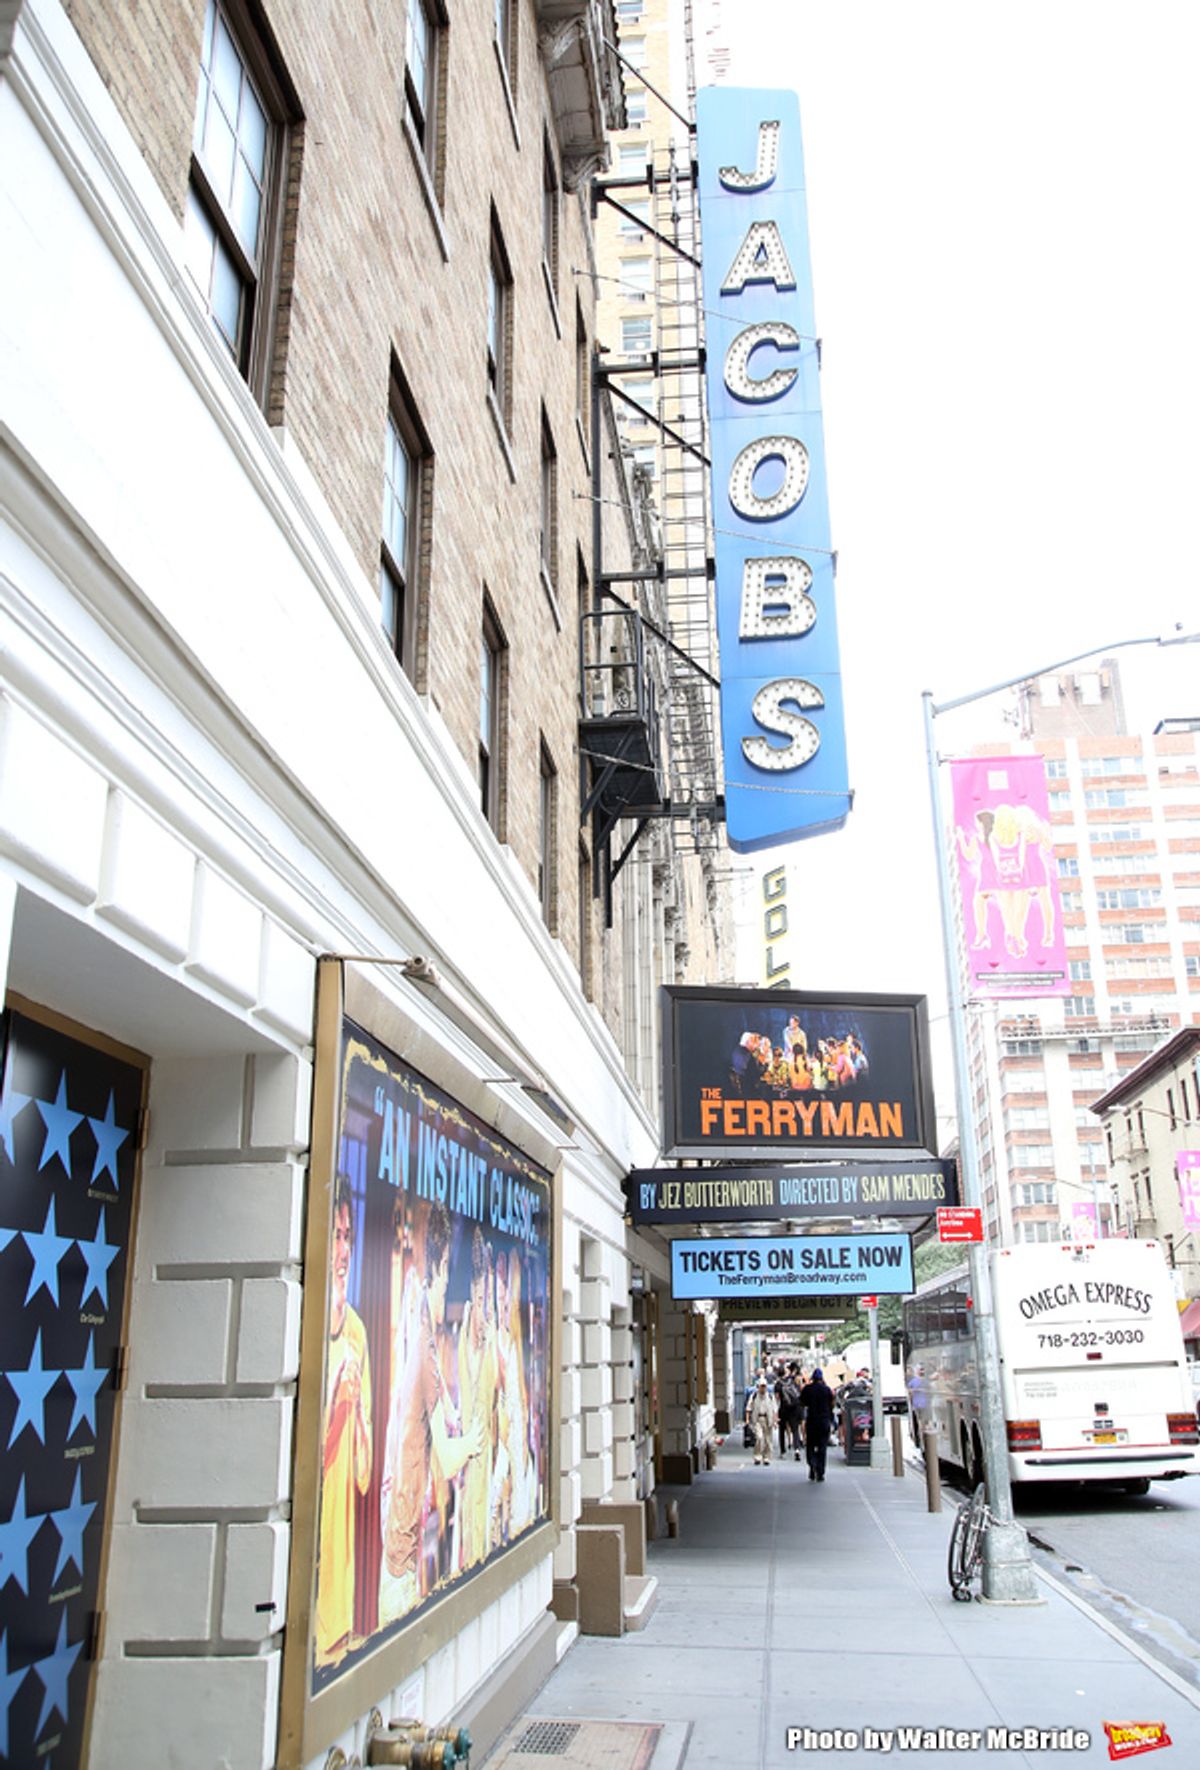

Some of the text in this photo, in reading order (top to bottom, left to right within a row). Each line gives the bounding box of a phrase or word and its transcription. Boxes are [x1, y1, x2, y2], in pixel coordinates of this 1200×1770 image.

[718, 119, 826, 774] JACOBS
[701, 1087, 722, 1100] THE
[700, 1099, 904, 1138] FERRYMAN
[415, 1120, 488, 1223] INSTANT
[639, 1172, 946, 1210] BY JEZ BUTTERWORTH DIRECTED BY SAM MENDES
[680, 1245, 903, 1273] TICKETS ON SALE NOW
[717, 1271, 868, 1287] TheFerrymanBroadway.com
[722, 1298, 780, 1311] PREVIEWS
[1019, 1281, 1153, 1320] OMEGA EXPRESS
[1037, 1329, 1145, 1349] 718-232-3030
